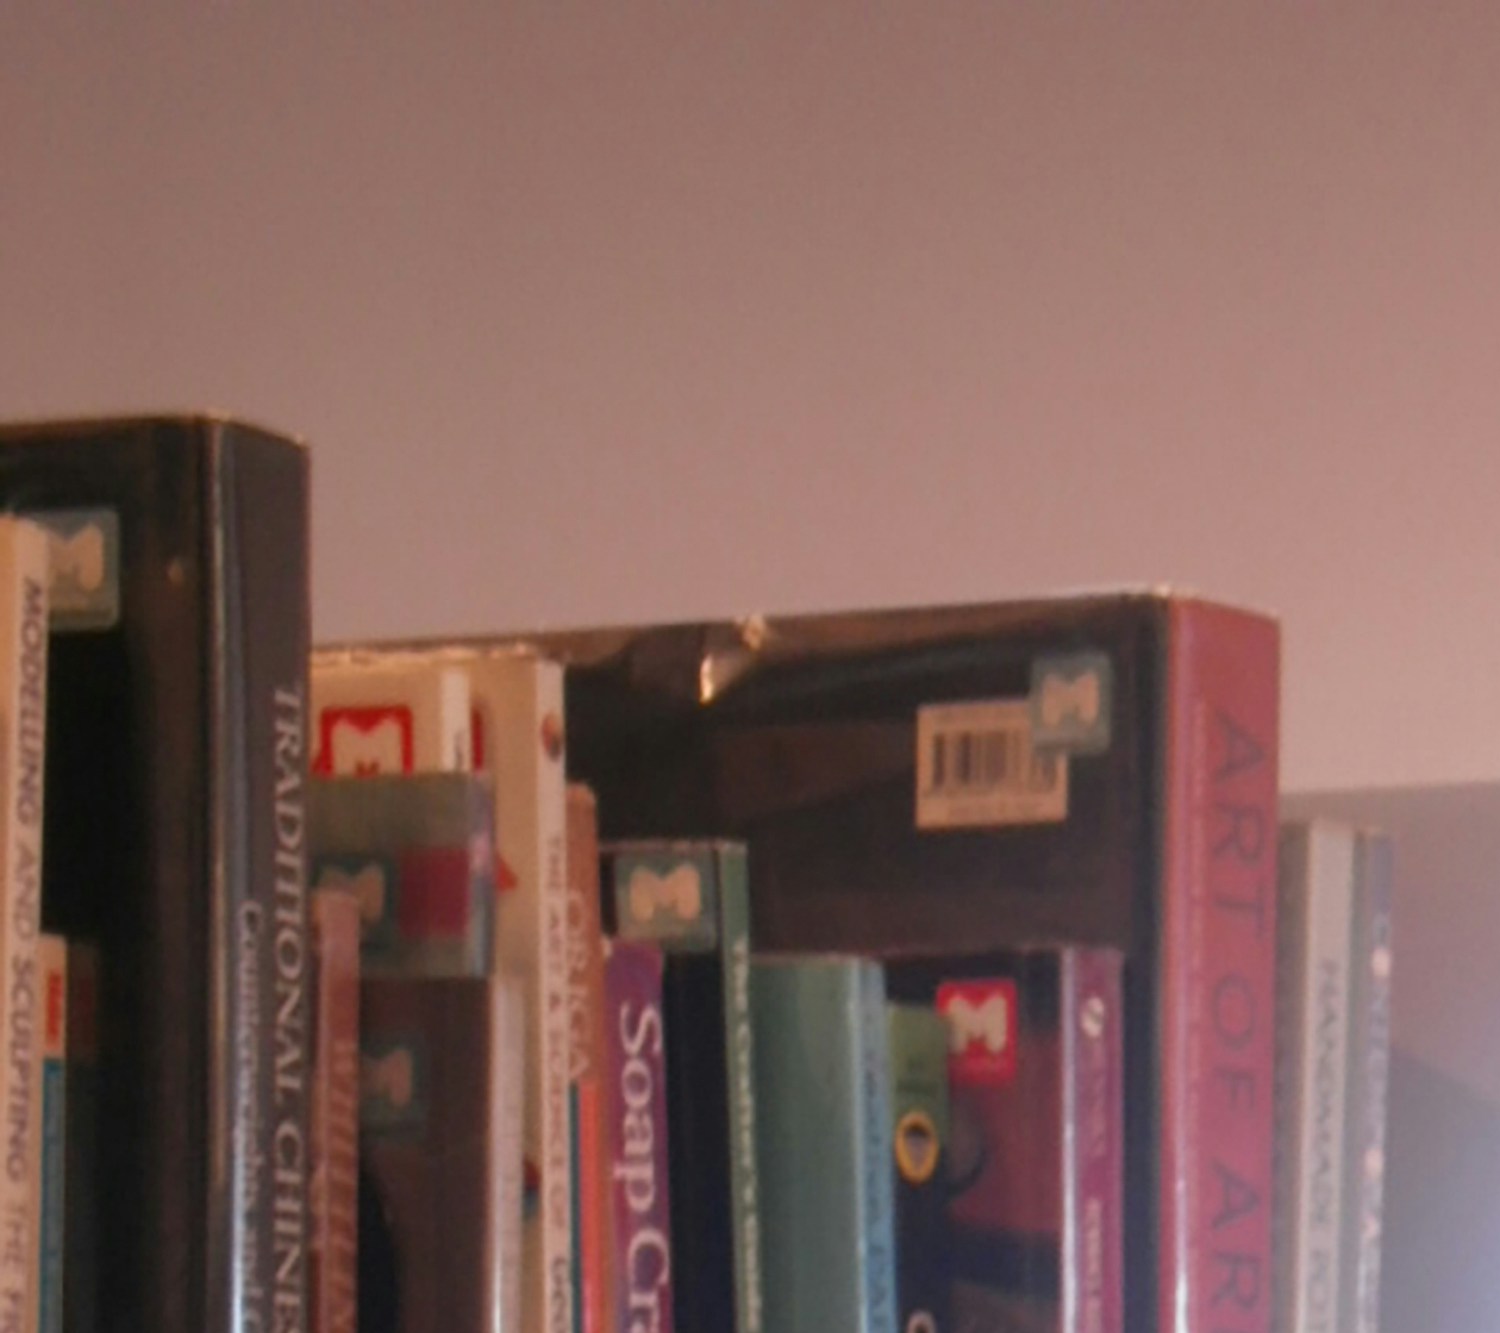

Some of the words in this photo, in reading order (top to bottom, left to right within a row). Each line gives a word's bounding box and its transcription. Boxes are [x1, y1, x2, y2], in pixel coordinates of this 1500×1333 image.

[16, 575, 47, 825] MODELLING
[13, 838, 39, 940] AND
[273, 685, 304, 1102] TRADITIONAL
[1209, 705, 1268, 940] ART
[8, 954, 38, 1184] SCULPTING
[612, 1000, 664, 1214] Soap
[1211, 971, 1258, 1116] OF
